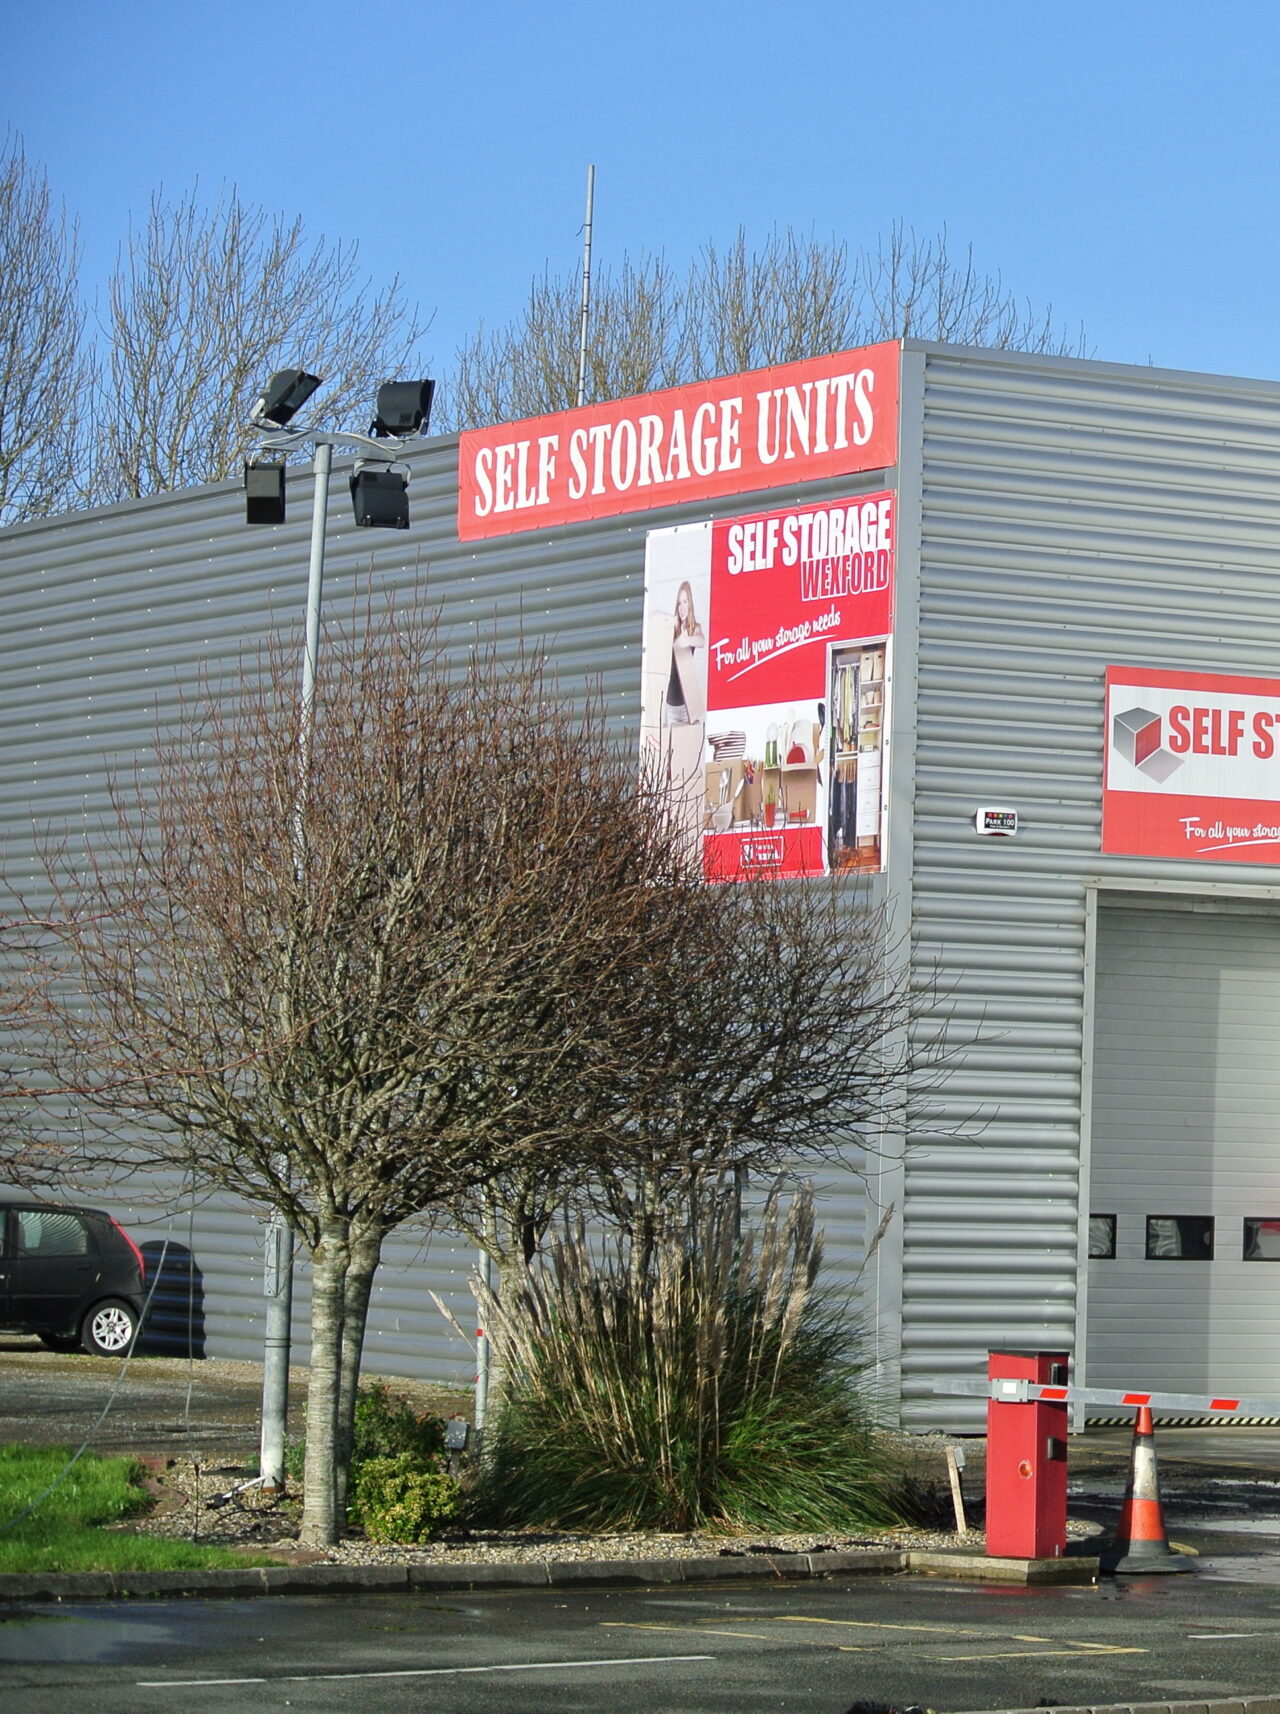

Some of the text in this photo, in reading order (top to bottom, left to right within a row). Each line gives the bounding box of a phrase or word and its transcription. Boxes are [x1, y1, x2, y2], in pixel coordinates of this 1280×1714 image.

[474, 368, 874, 517] SELF STORAGE UNITS
[728, 499, 891, 575] SELF STORAGE
[801, 549, 889, 601] WEXFORD
[710, 604, 841, 671] For all your storage needs
[1168, 705, 1245, 756] SELF
[1179, 816, 1206, 839] For
[1208, 821, 1224, 838] all
[1226, 825, 1250, 843] your
